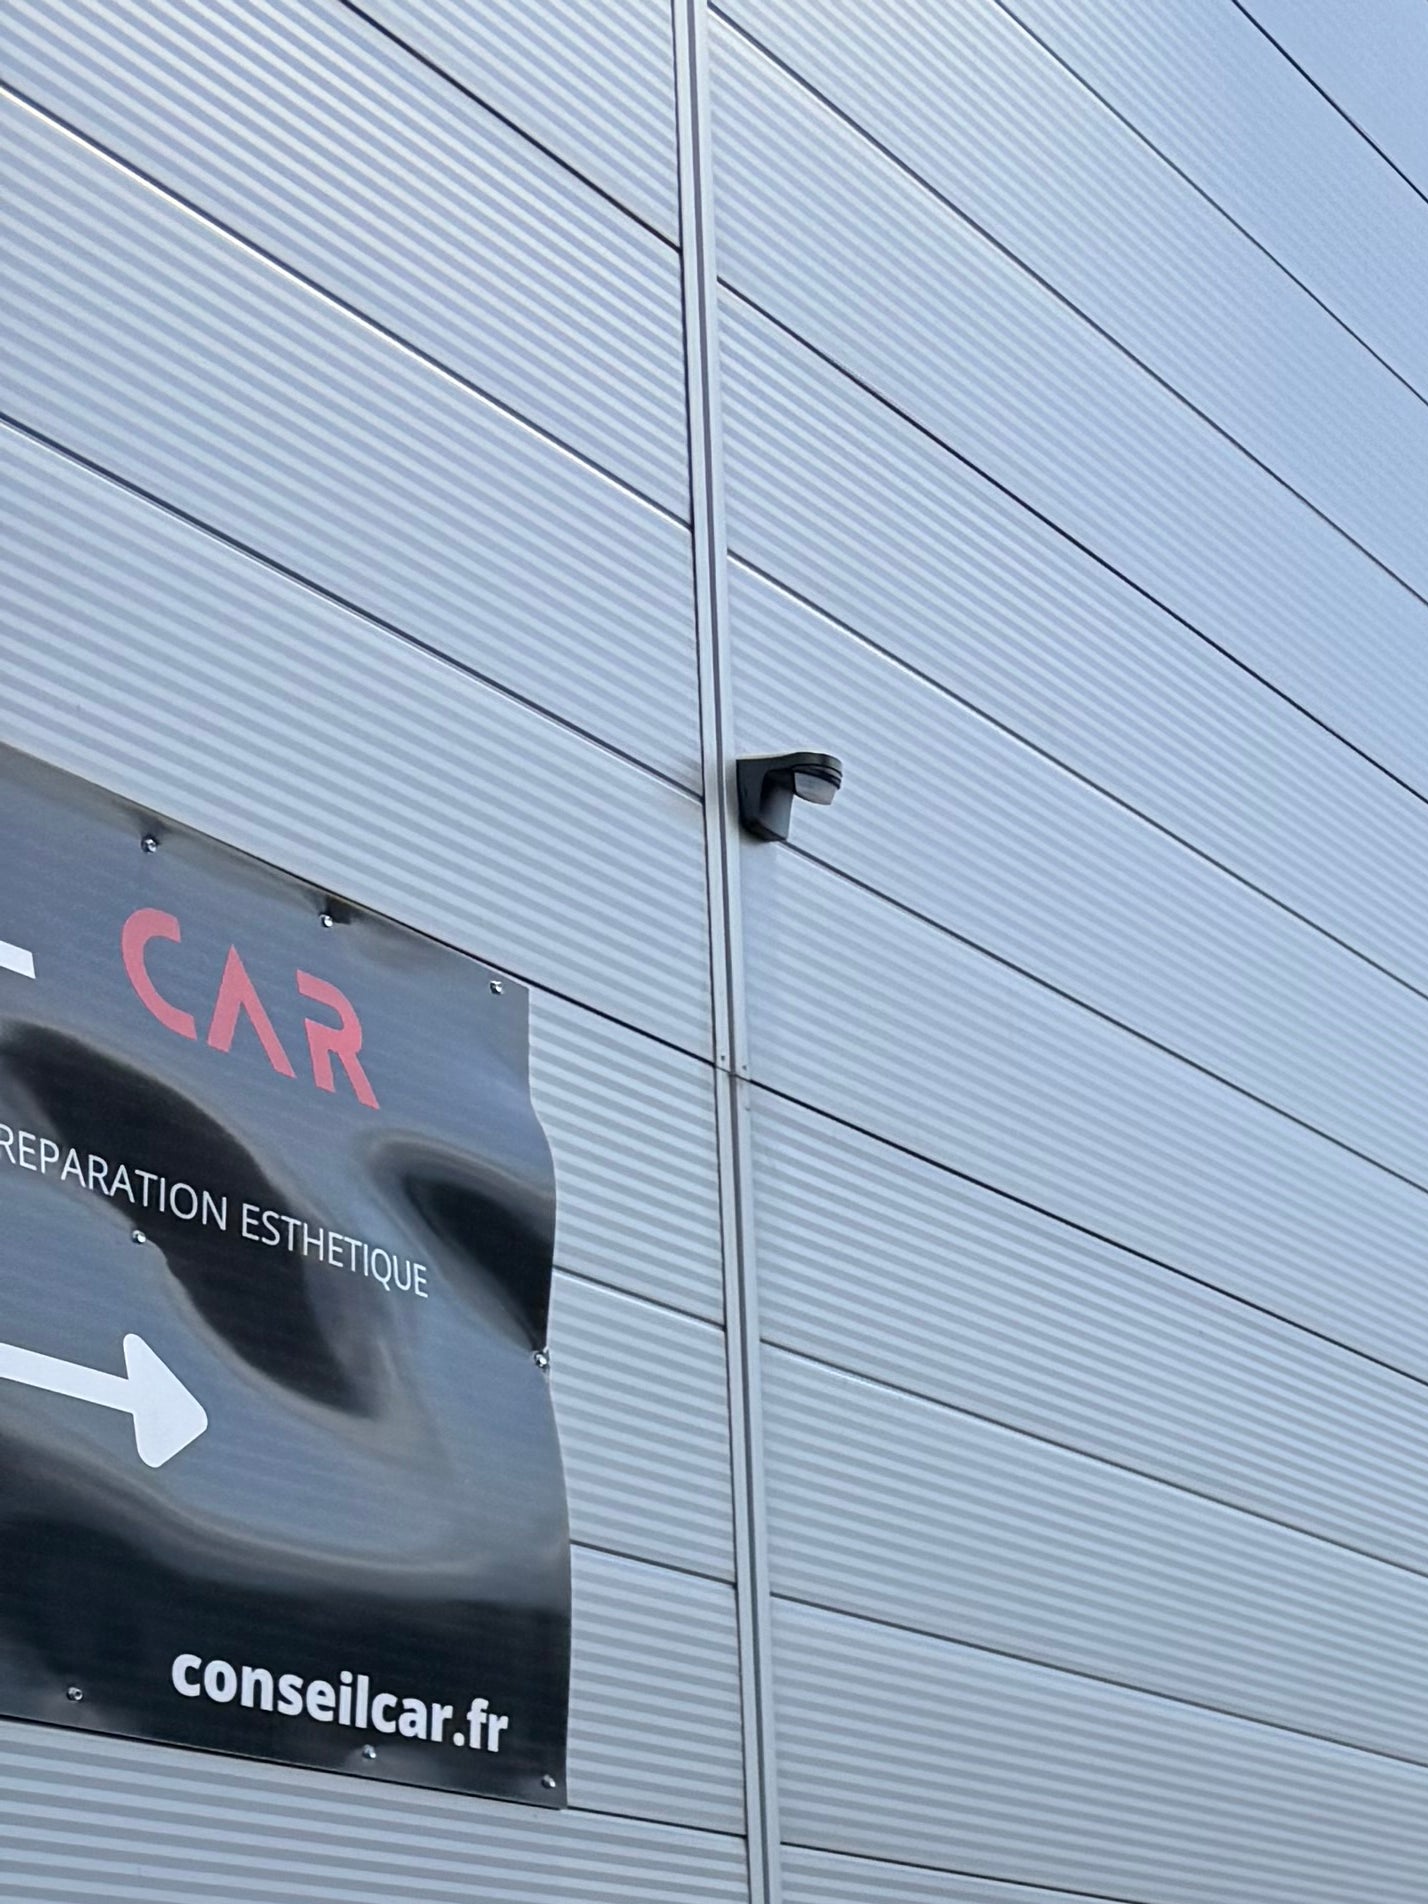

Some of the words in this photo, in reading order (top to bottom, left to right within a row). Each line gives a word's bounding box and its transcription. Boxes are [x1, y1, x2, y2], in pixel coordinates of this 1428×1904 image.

[120, 907, 381, 1111] CAR
[241, 1203, 430, 1299] ESTHETIQUE
[171, 1653, 510, 1753] conseilcar.fr
